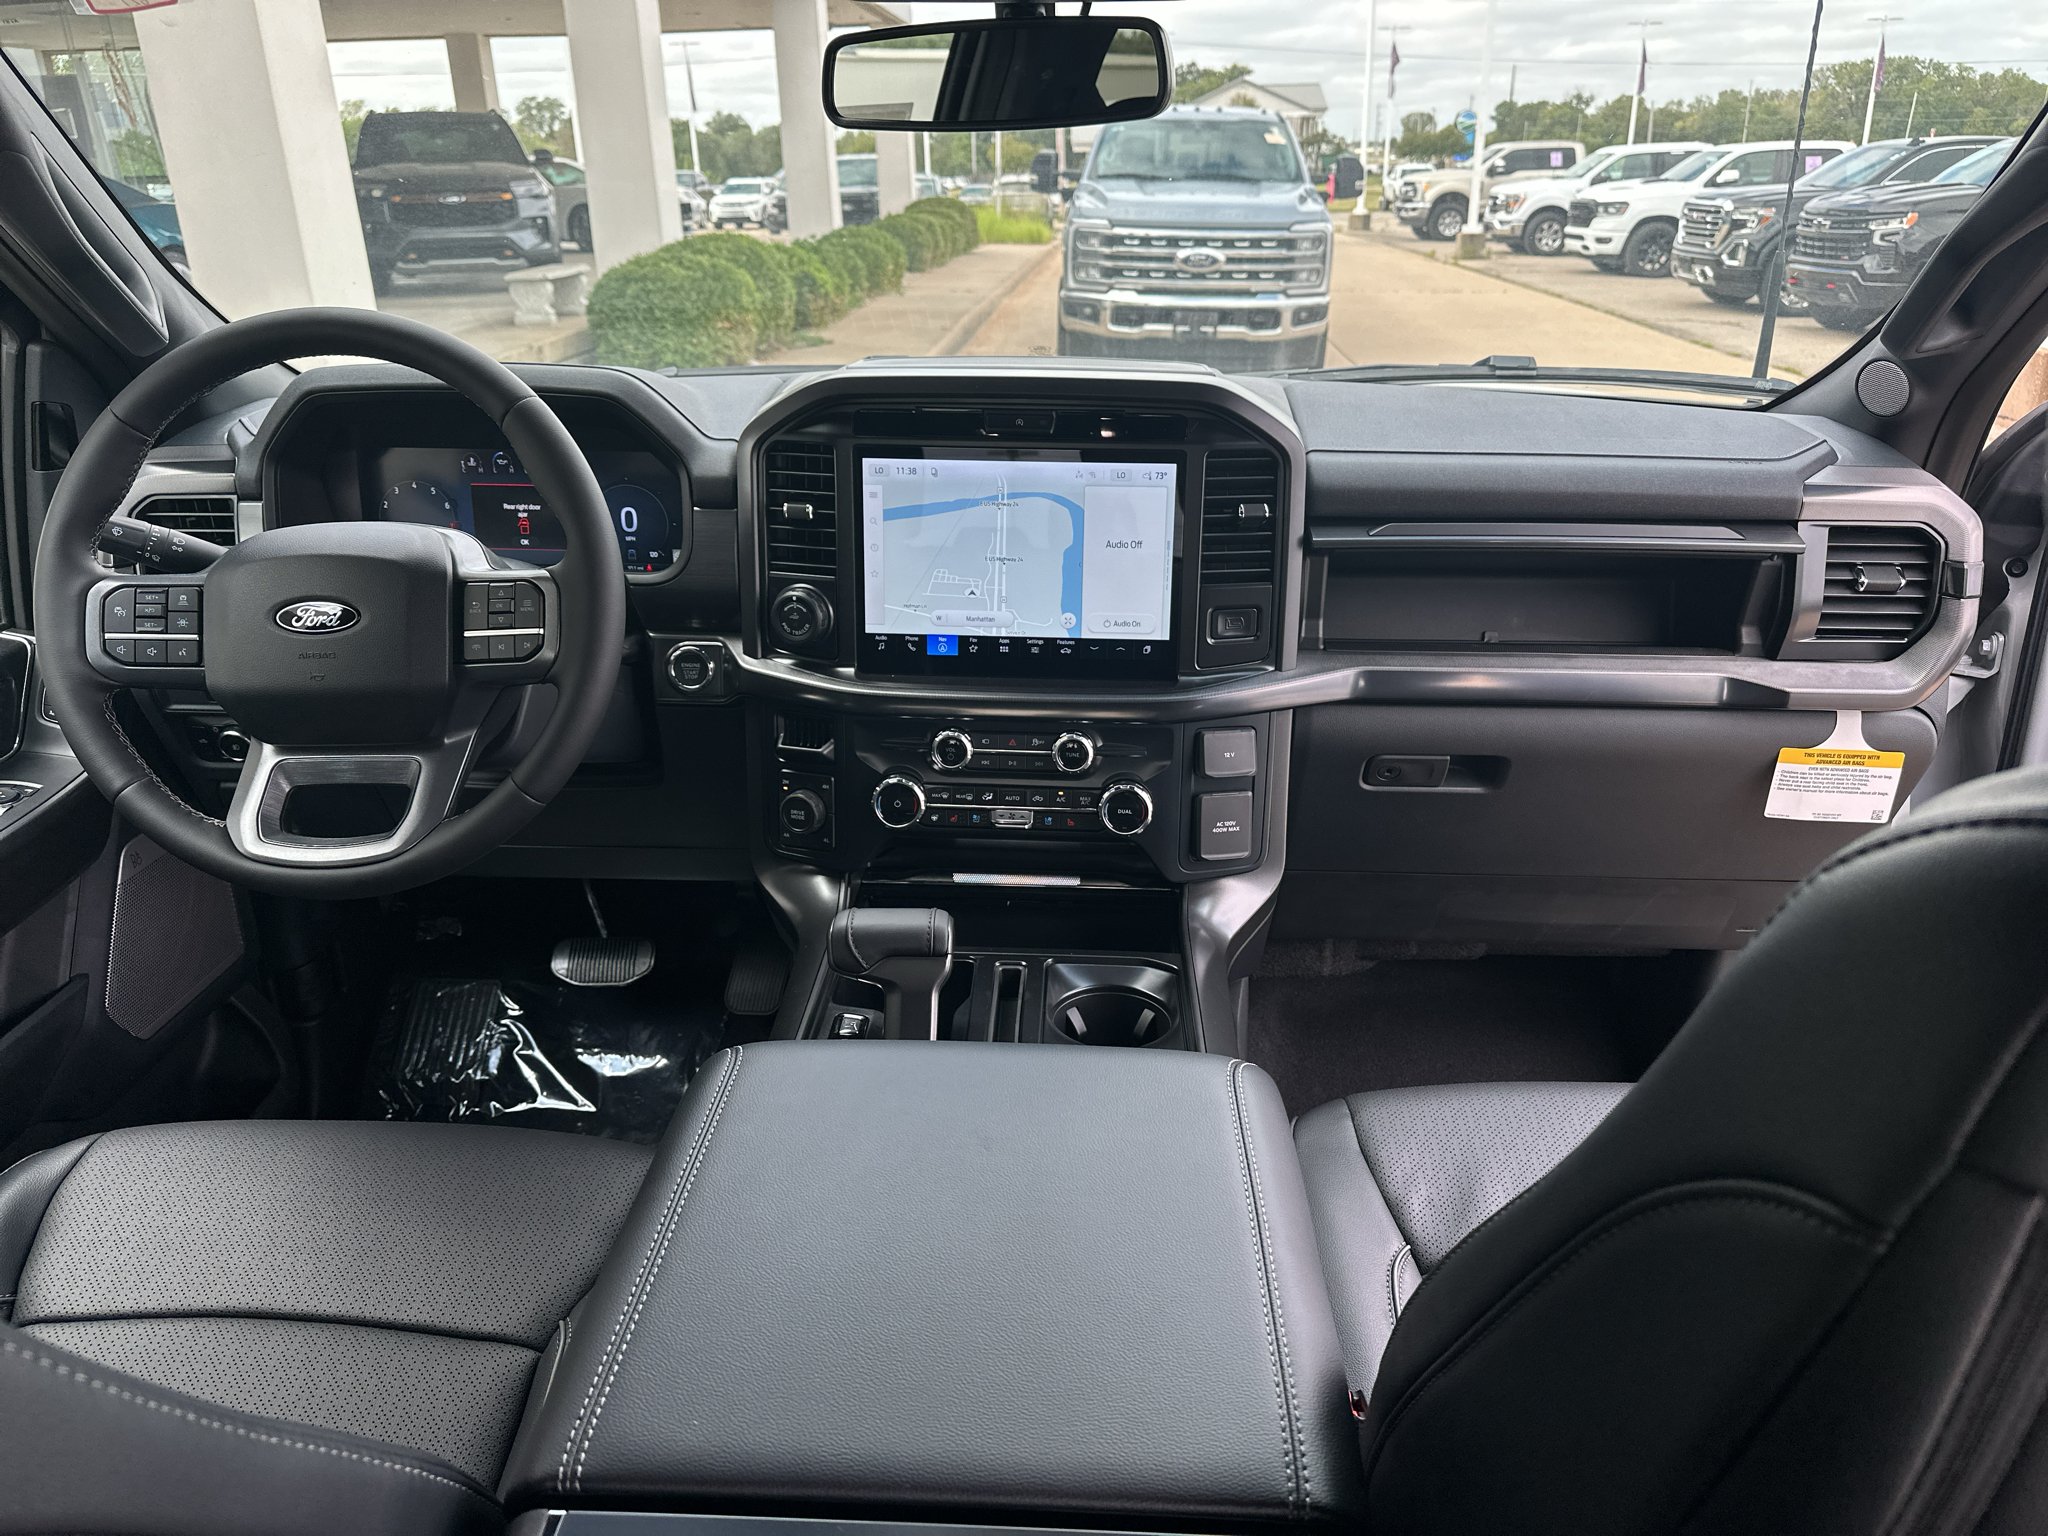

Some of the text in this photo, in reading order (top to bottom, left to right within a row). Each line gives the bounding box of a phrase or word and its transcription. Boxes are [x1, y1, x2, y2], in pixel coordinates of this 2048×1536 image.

[896, 467, 917, 475] 11:38
[620, 506, 638, 532] 0
[1106, 540, 1143, 549] Audio Off
[292, 606, 343, 627] Ford
